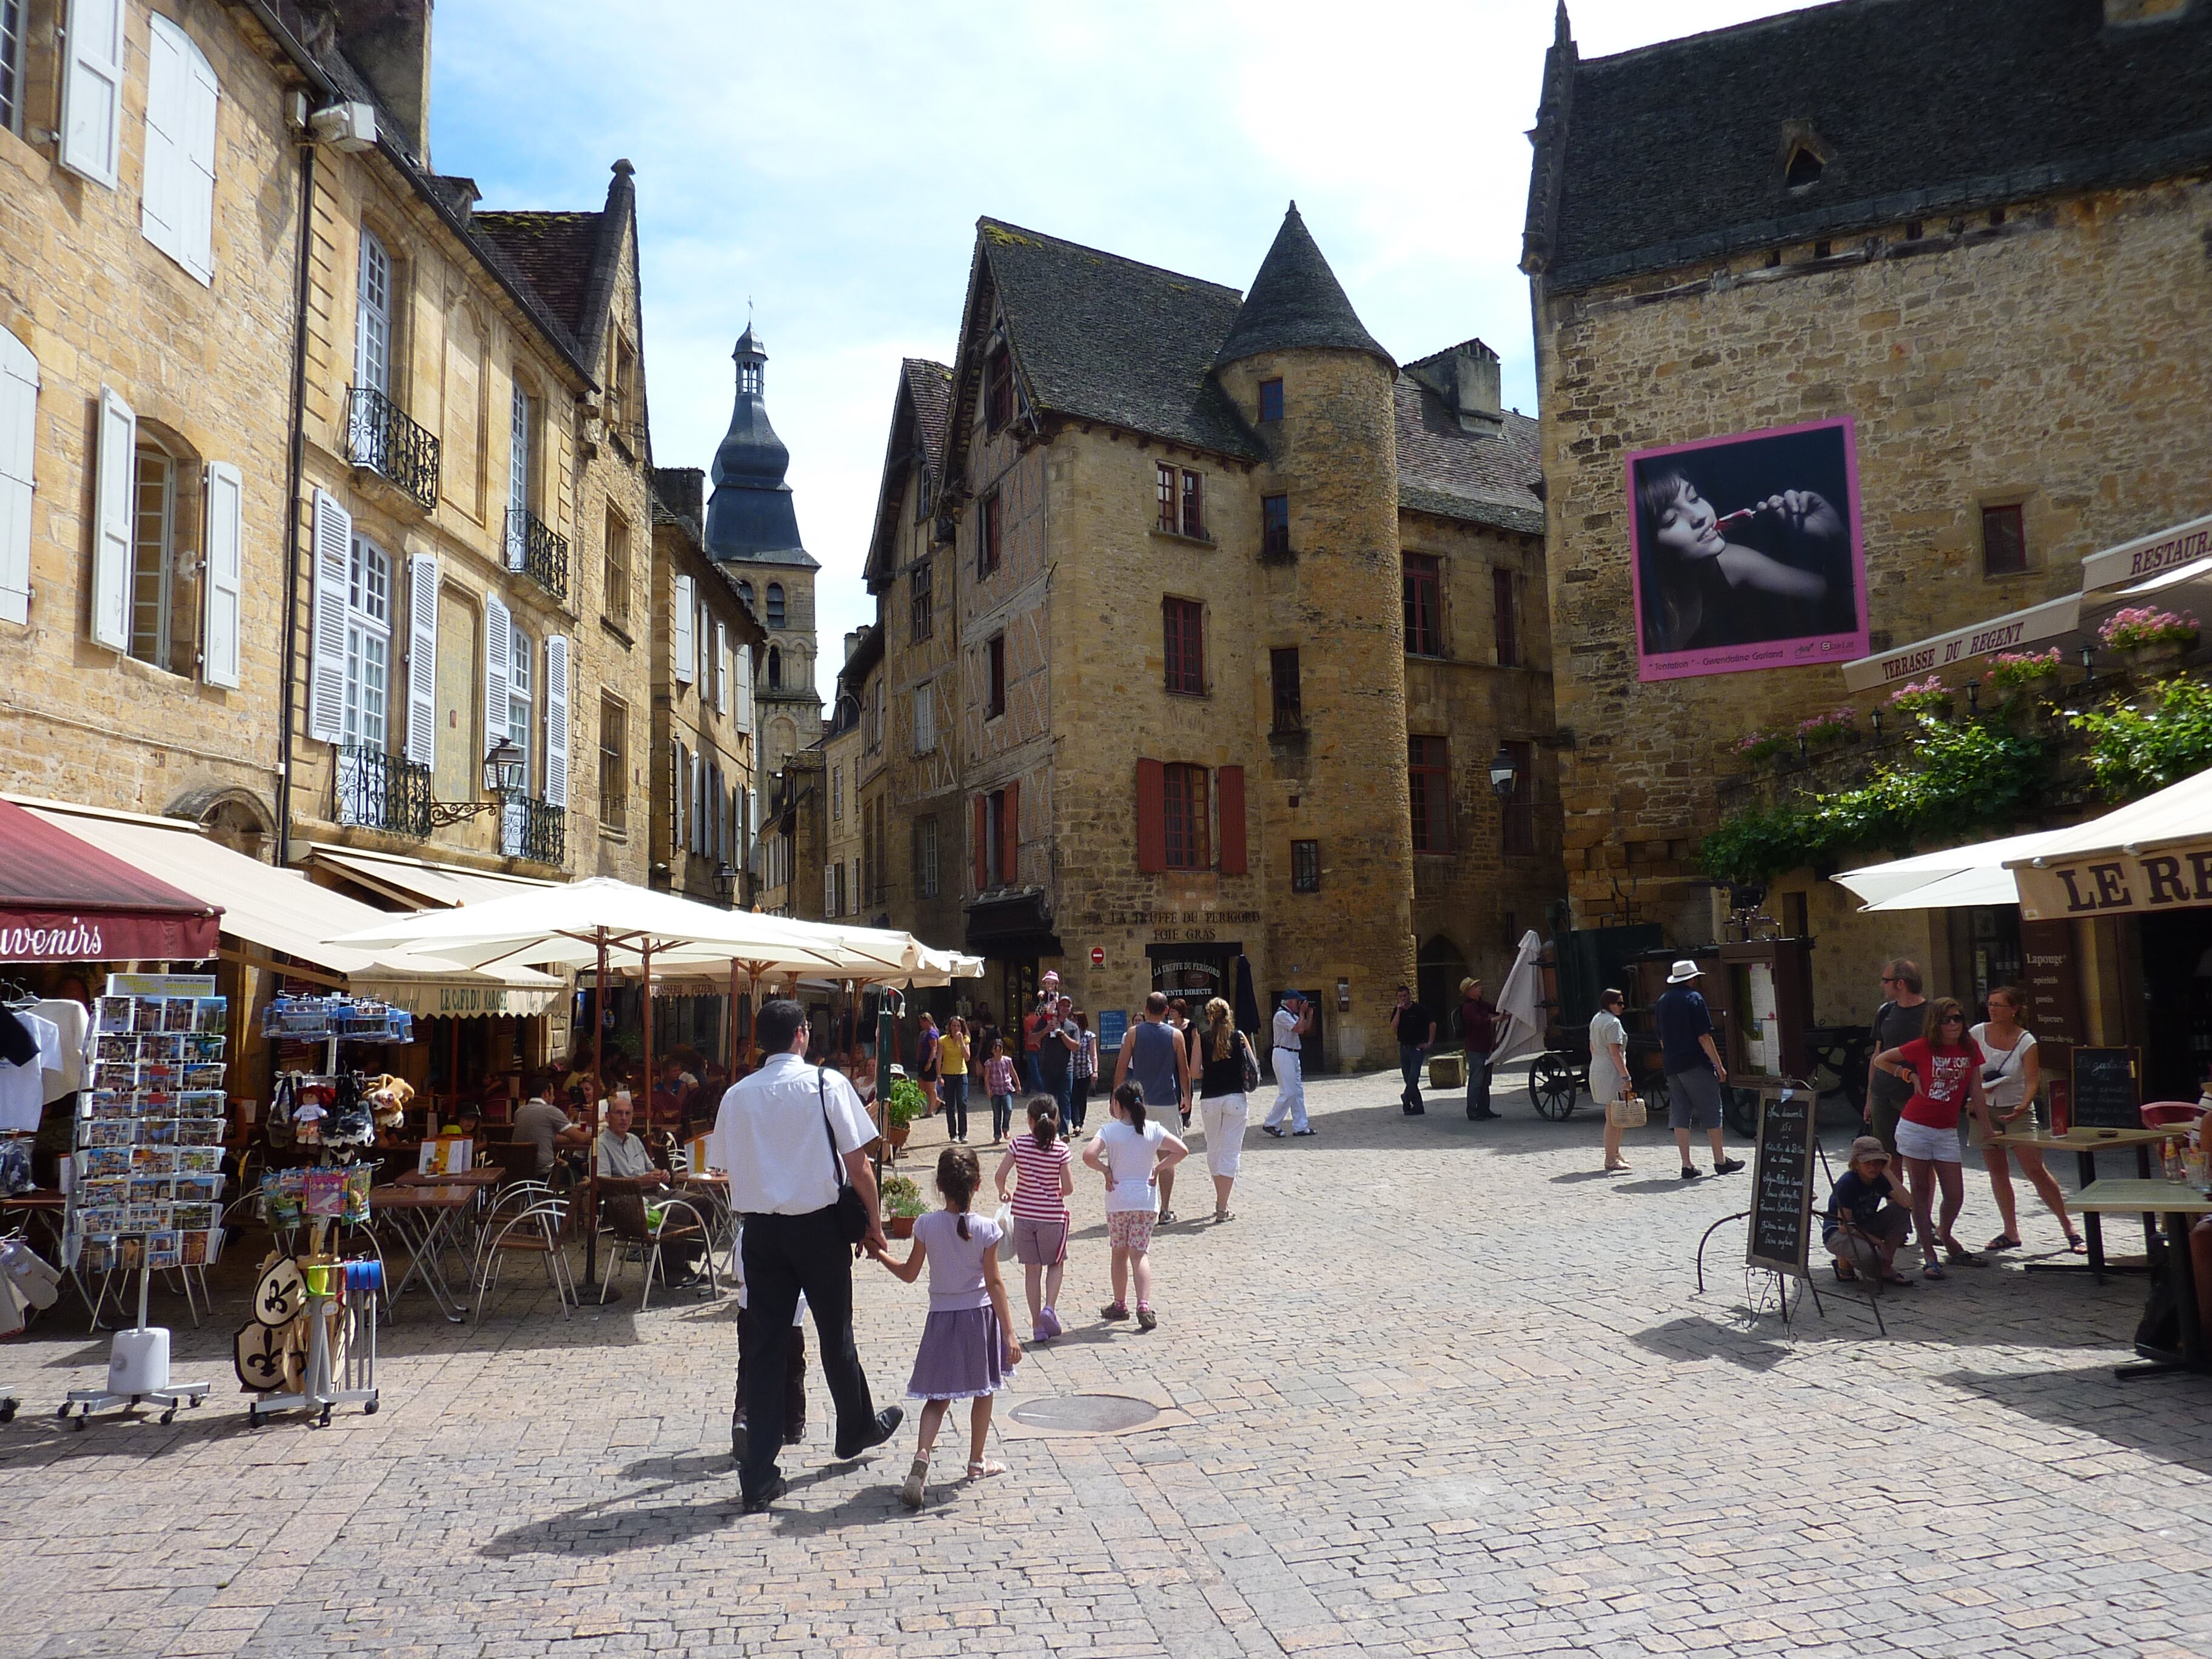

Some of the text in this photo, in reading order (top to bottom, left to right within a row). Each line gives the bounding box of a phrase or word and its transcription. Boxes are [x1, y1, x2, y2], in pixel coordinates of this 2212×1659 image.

[1703, 654, 1749, 666] Gwendoline
[1752, 651, 1783, 660] Garland
[1882, 622, 2024, 680] TERRASSE DU REGENT
[2056, 862, 2133, 911] LE
[1111, 912, 1126, 923] LA
[1135, 911, 1176, 923] TRUFFE
[1183, 911, 1198, 922] DU
[1205, 911, 1260, 923] PERIGORD
[1154, 928, 1216, 940] FOIE GRAS
[1154, 967, 1161, 977] LA
[1162, 962, 1183, 973] TRUFFE
[1193, 962, 1220, 978] PERIGORD
[651, 984, 717, 994] BRASSERIE PIZZERIA
[441, 989, 451, 1011] LE
[471, 990, 480, 1010] DU
